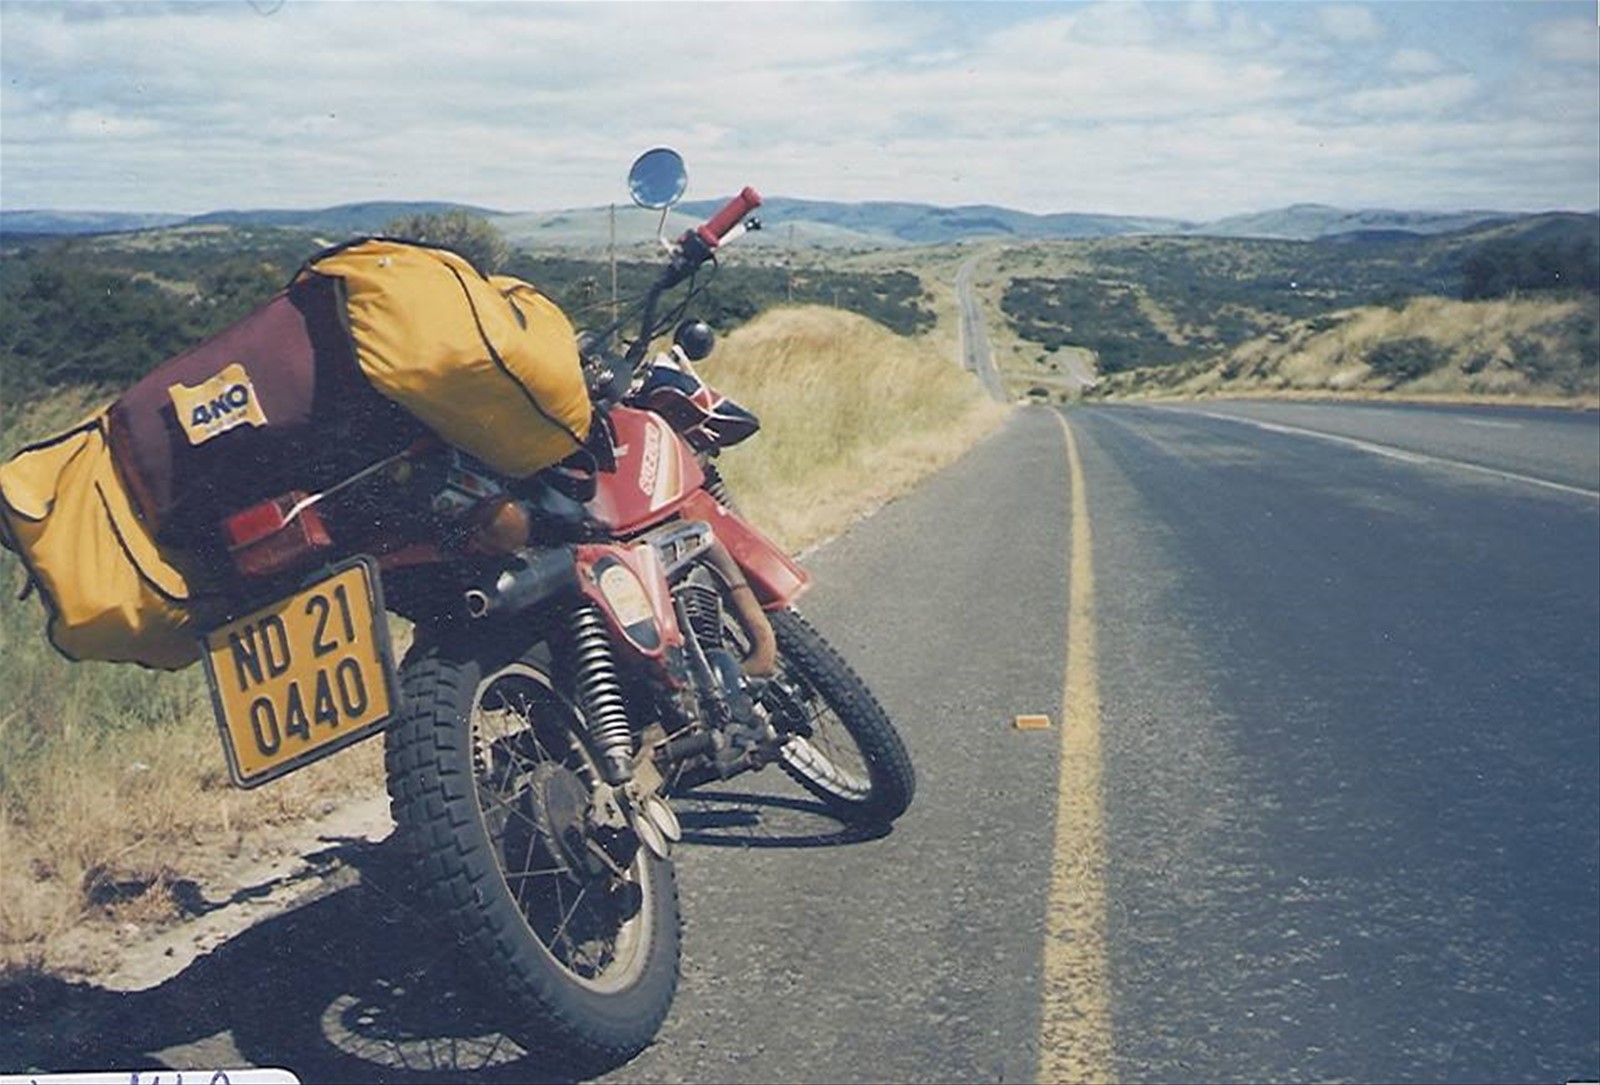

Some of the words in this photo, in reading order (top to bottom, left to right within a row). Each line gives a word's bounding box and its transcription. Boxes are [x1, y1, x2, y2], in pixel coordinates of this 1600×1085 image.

[228, 613, 291, 693] ND
[305, 584, 355, 658] 21
[250, 657, 368, 757] 0440
